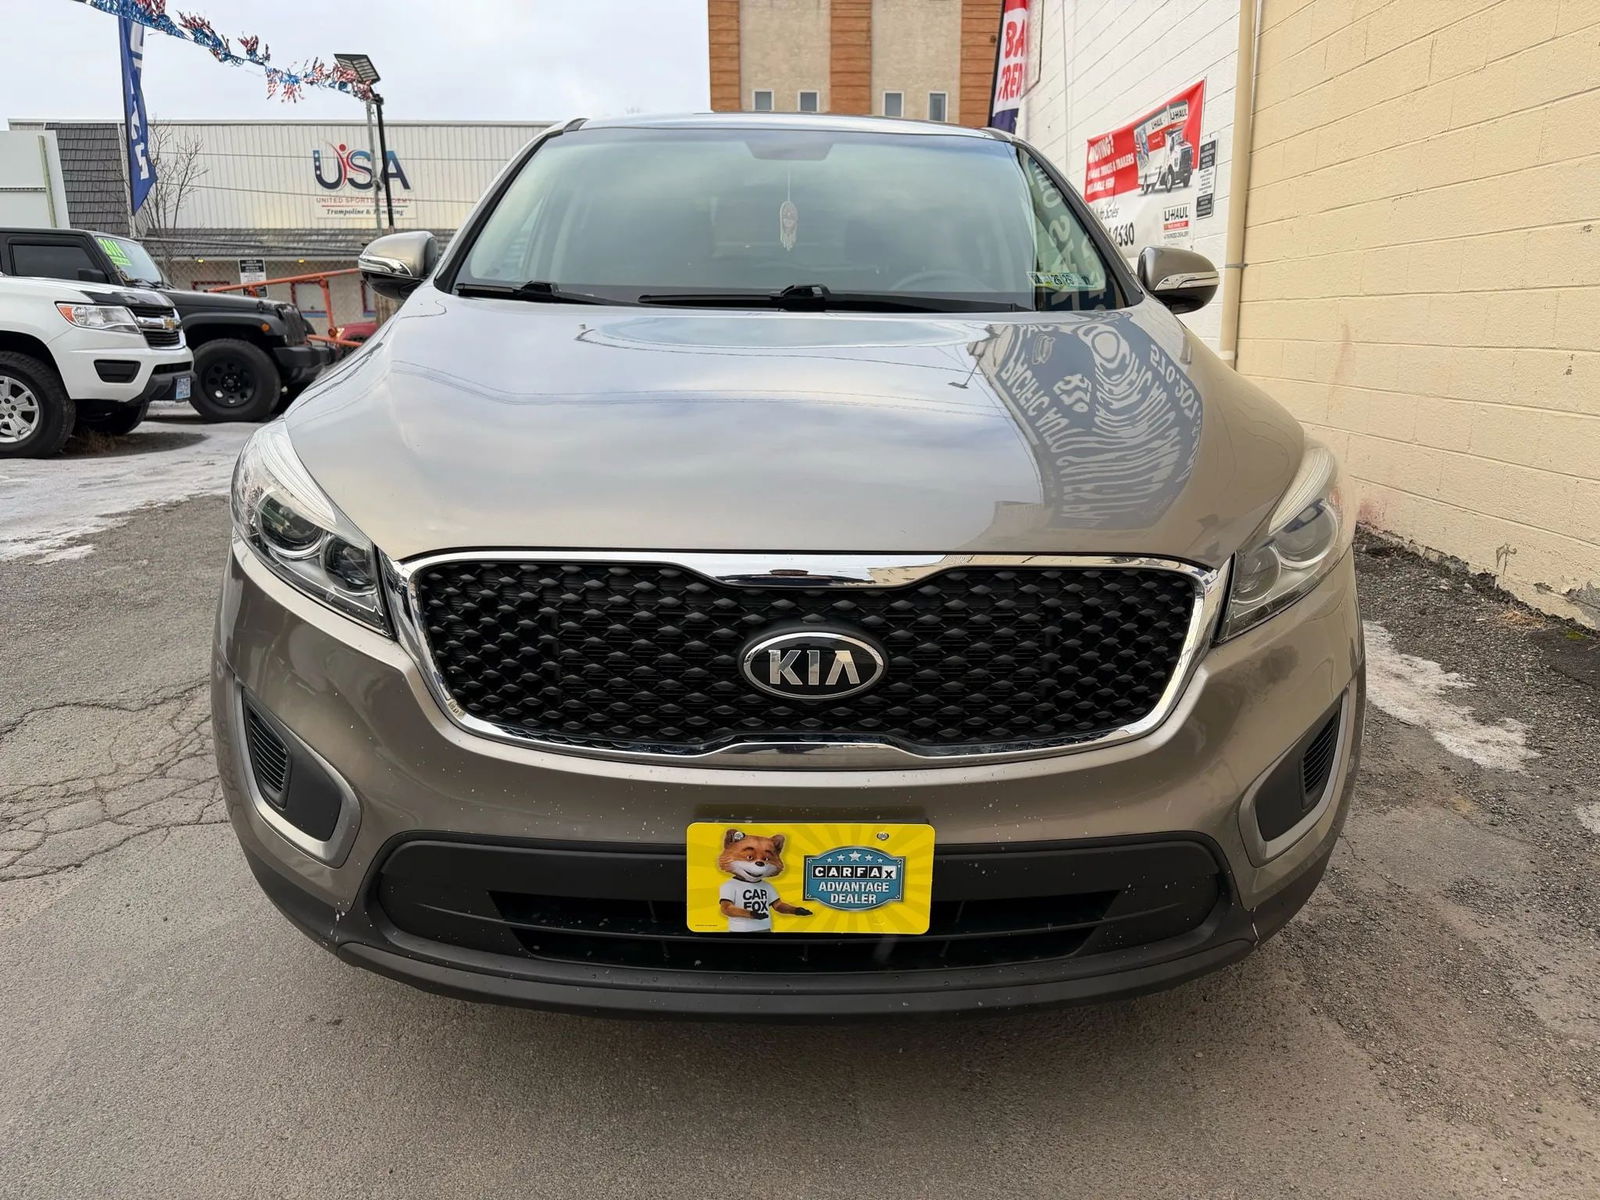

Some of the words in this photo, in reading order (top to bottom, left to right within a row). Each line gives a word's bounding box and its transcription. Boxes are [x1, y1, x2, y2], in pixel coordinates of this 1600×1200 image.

[312, 150, 412, 190] USA
[326, 208, 364, 216] Trampoline
[1164, 206, 1189, 222] U-HAUL
[768, 650, 861, 686] KIA
[814, 866, 894, 879] CARFAX
[818, 881, 890, 893] ADVANTAGE
[742, 889, 768, 901] CAR
[830, 893, 877, 904] DEALER
[743, 901, 769, 912] FOX
